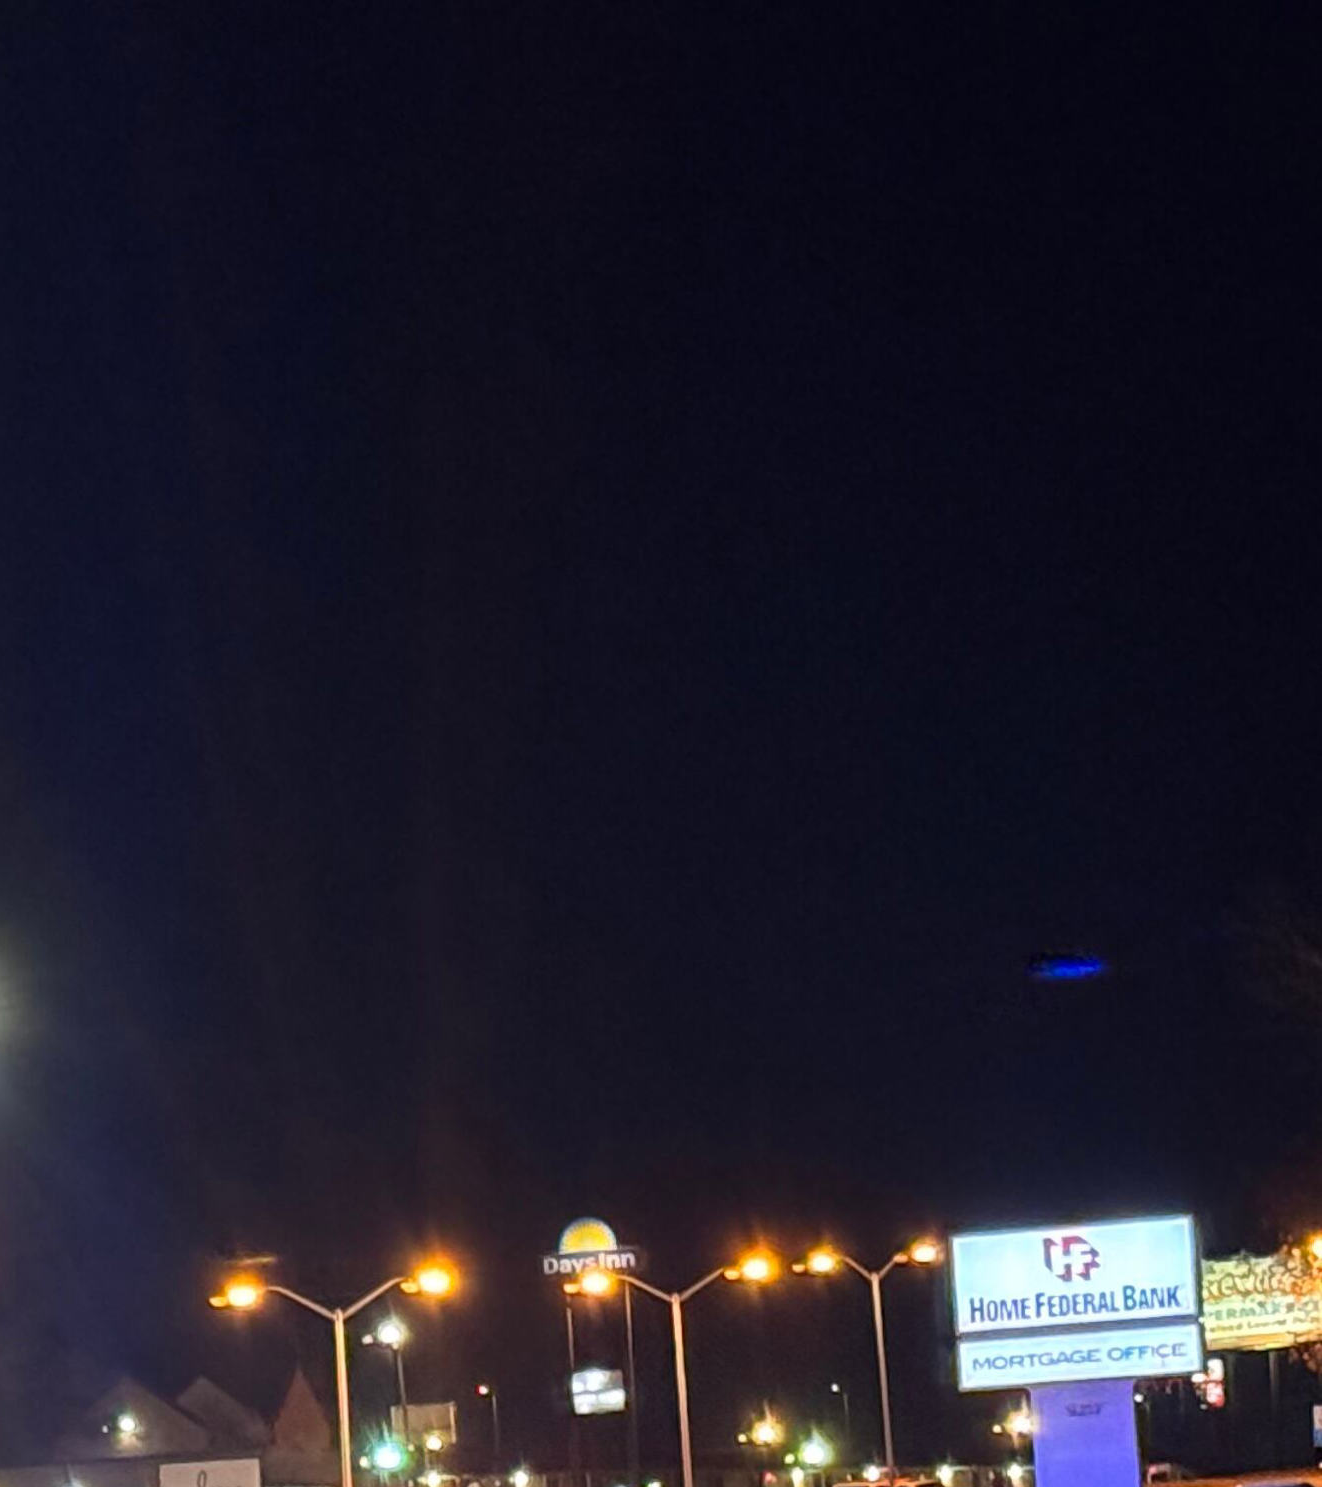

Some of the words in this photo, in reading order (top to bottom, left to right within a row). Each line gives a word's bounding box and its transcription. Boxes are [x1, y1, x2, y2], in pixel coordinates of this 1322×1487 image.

[543, 1255, 597, 1275] Days
[598, 1252, 636, 1270] Inn
[972, 1349, 1102, 1372] MORTGAGE
[1107, 1342, 1188, 1362] OFFICE
